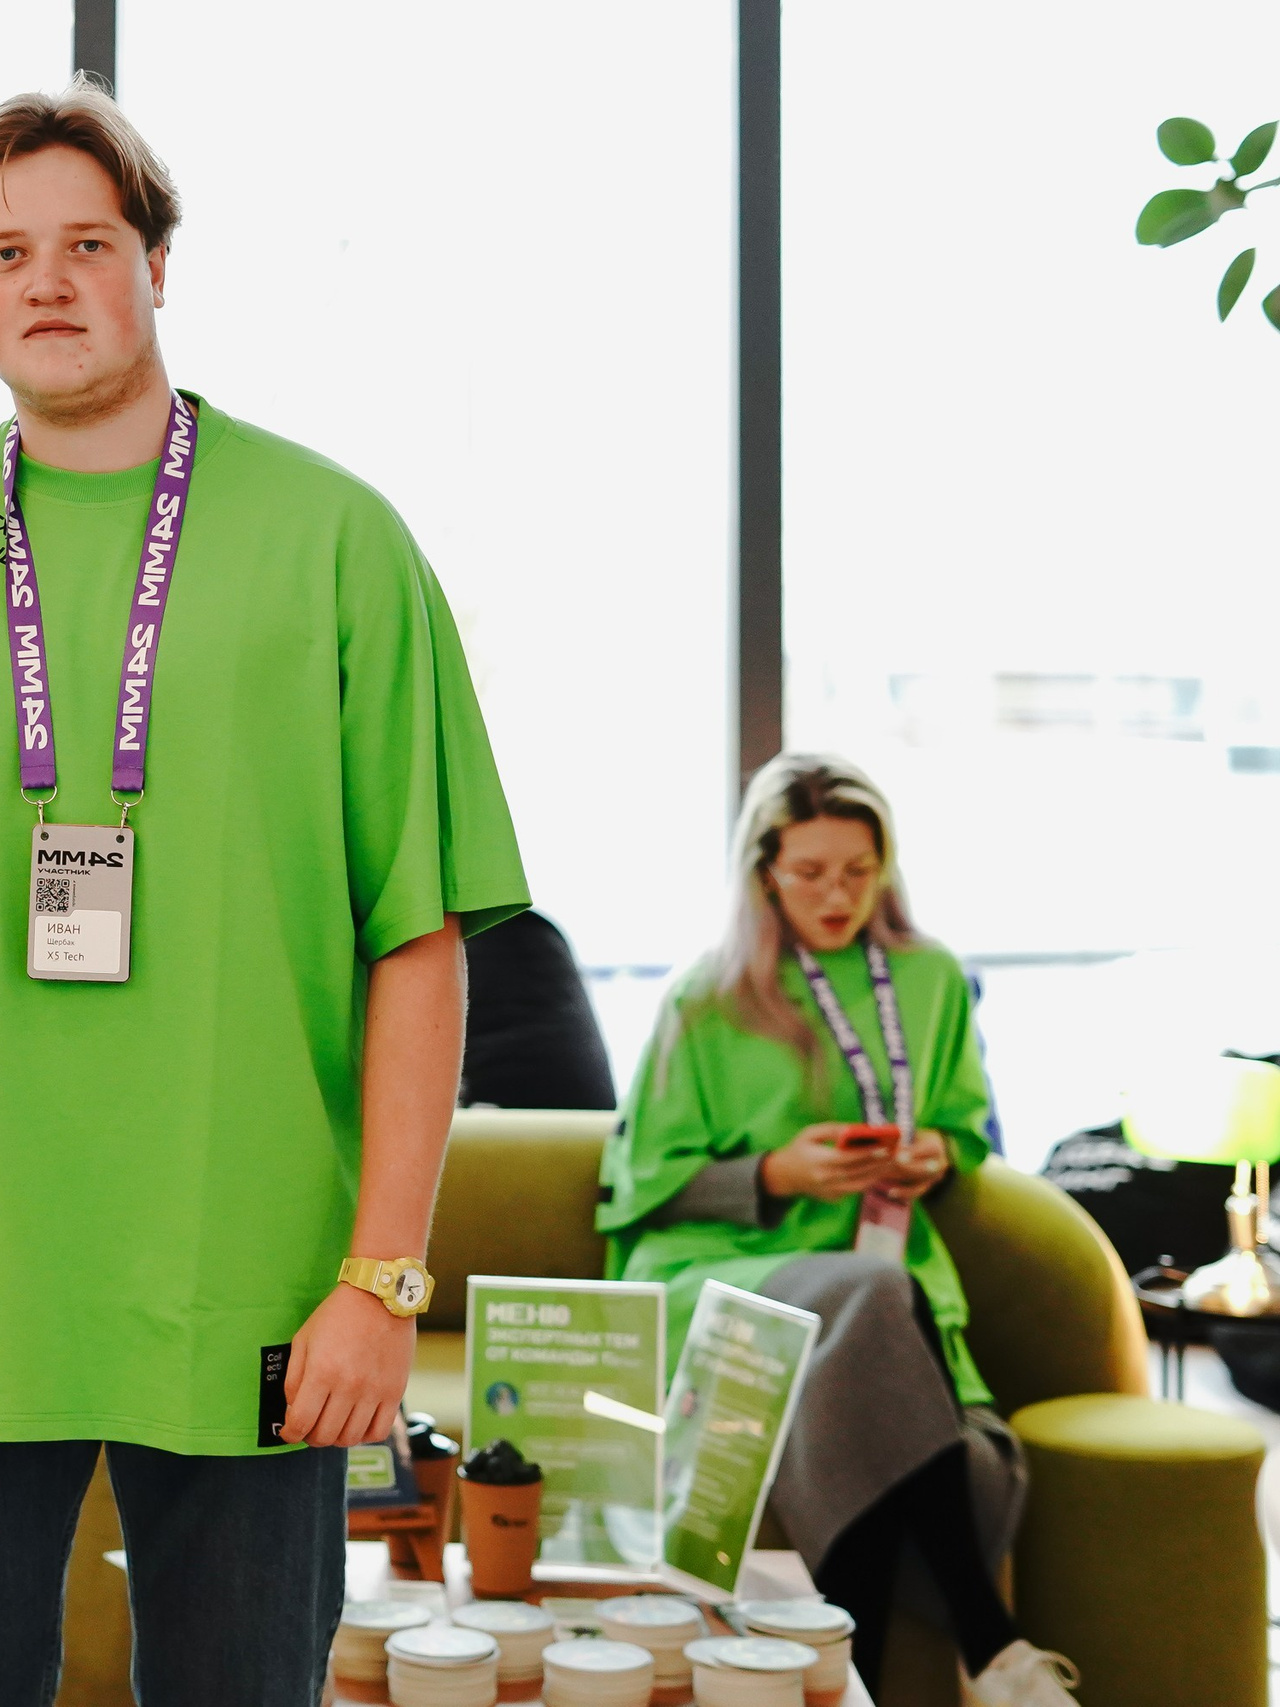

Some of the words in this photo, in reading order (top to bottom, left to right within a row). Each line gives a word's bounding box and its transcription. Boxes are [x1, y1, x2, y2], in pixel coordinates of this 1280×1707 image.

[37, 867, 91, 876] УЧАСТНИК
[47, 923, 81, 935] ИВАН
[64, 952, 85, 962] Tech
